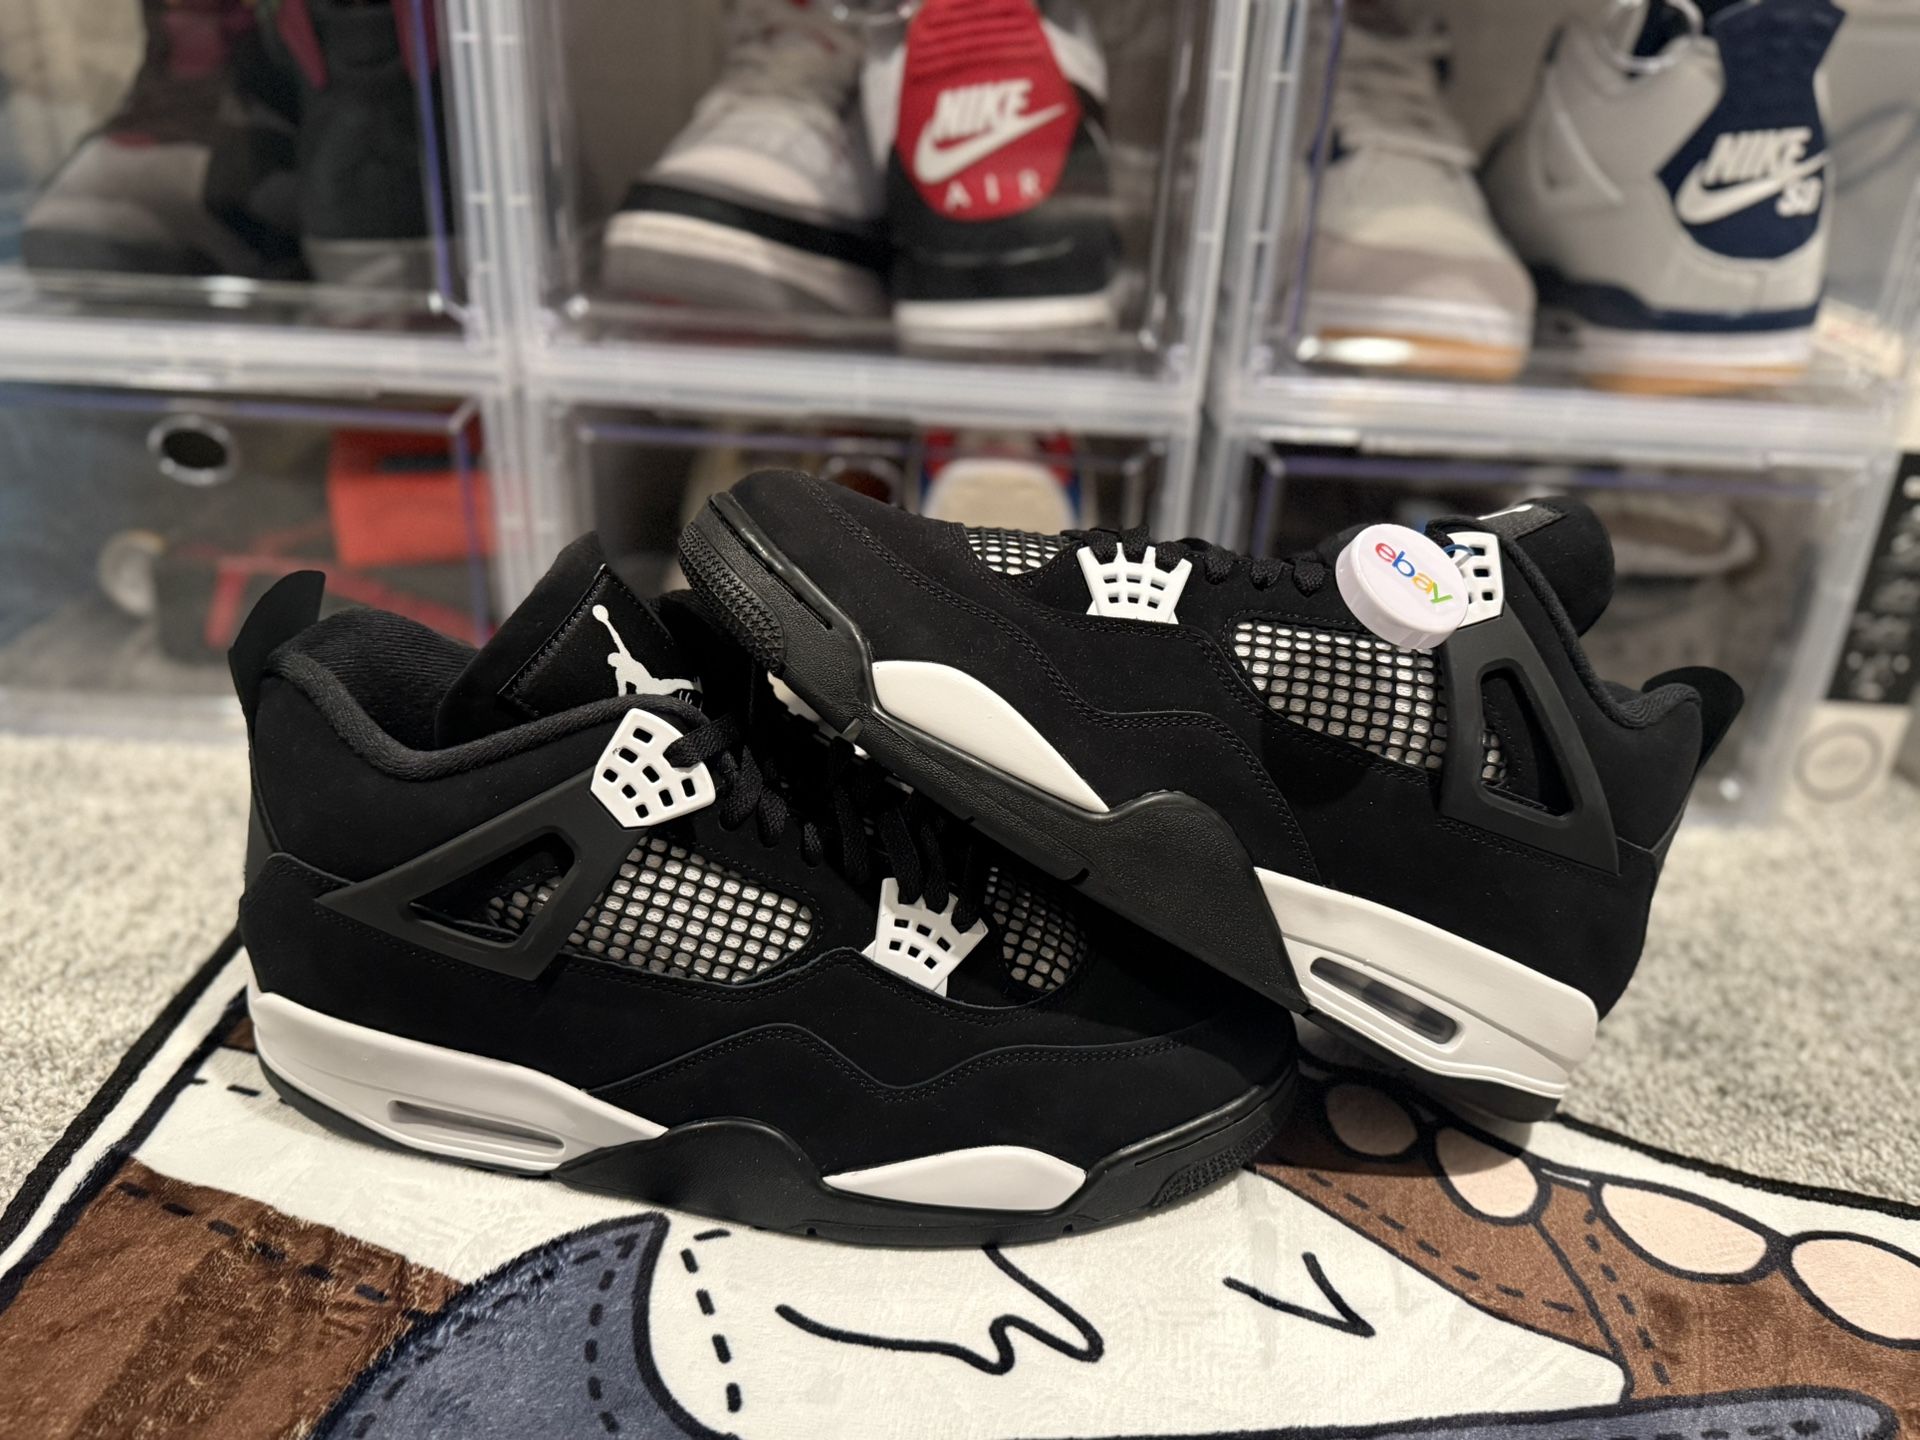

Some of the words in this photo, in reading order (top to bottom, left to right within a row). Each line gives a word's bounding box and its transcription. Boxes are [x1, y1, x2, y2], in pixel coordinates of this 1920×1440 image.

[937, 77, 1033, 139] NIKE
[1702, 126, 1812, 187] NIKE
[945, 169, 1042, 211] AIR
[1375, 542, 1454, 605] ebay
